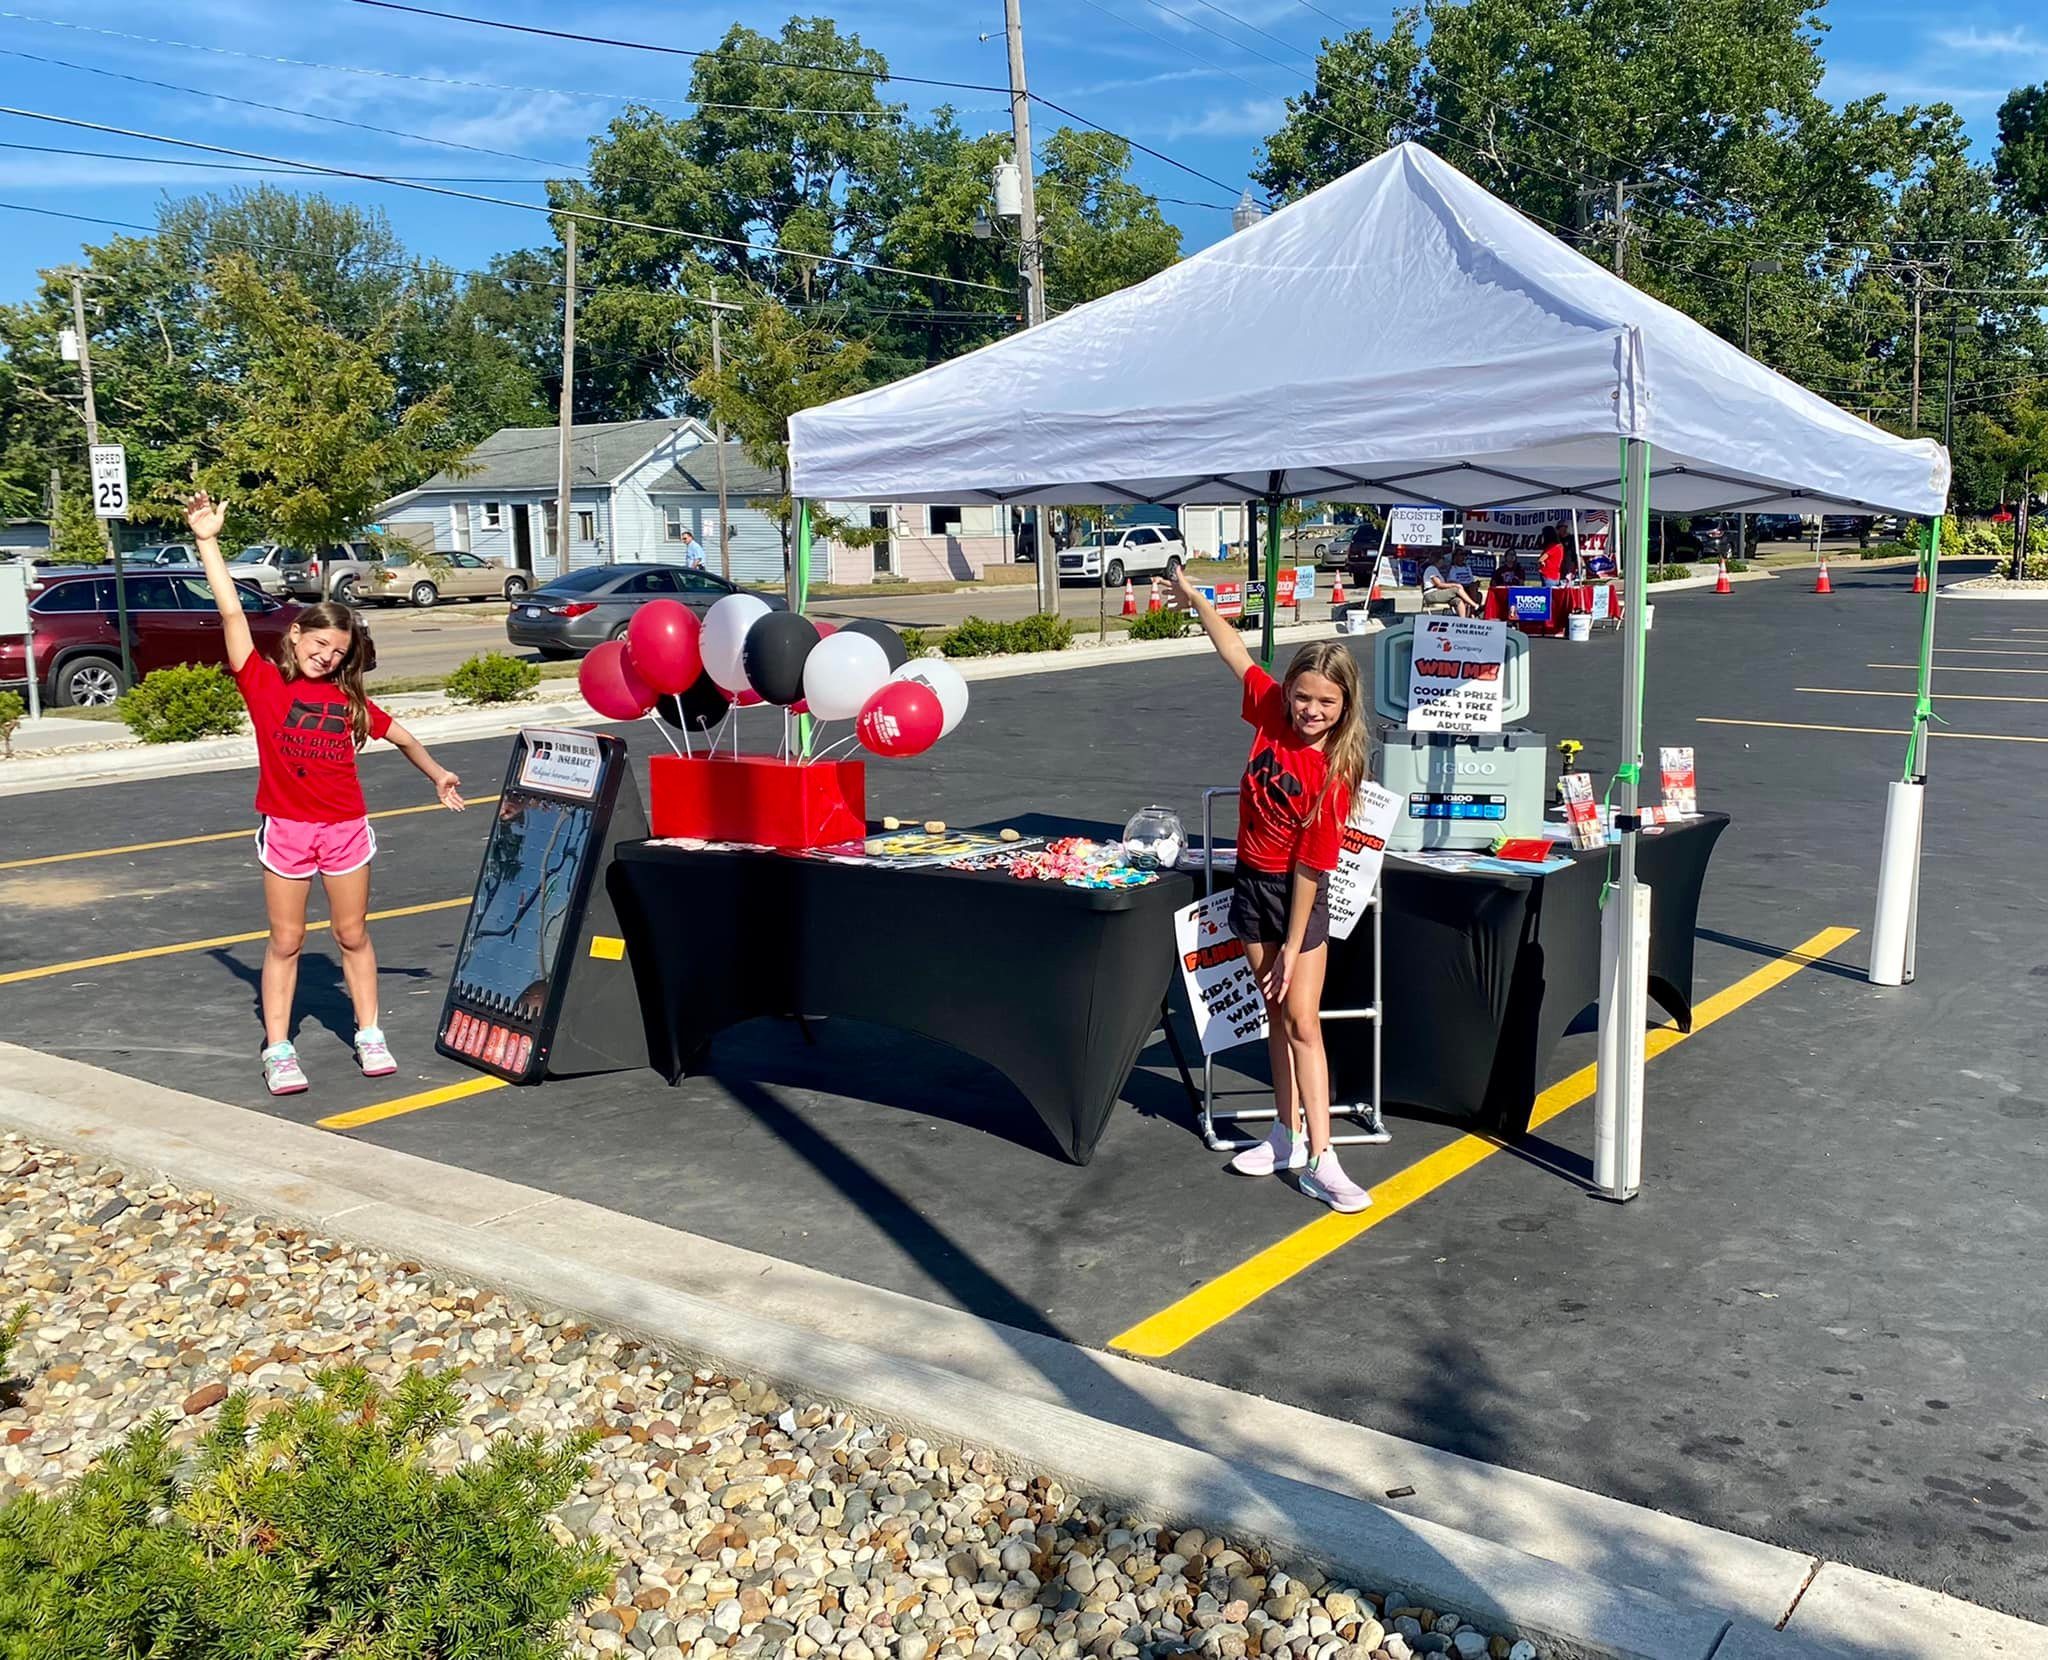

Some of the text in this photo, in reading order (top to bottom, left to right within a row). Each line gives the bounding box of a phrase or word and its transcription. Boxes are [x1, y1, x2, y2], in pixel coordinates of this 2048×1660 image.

[95, 453, 120, 465] SPEED
[98, 468, 119, 479] LIMIT
[98, 483, 123, 508] 25
[1392, 510, 1442, 521] REGISTER
[1514, 511, 1545, 526] Buren
[1410, 523, 1426, 533] TO
[1401, 533, 1433, 543] VOTE
[1464, 529, 1609, 551] REPUBLICA RTY
[1465, 556, 1494, 568] esbitt
[1515, 595, 1547, 603] TUDOR
[1453, 644, 1482, 653] Company
[1415, 658, 1461, 679] WIN
[1413, 686, 1498, 701] COOLER PRIZE
[1417, 698, 1494, 711] PACK. 1 FREE
[1422, 709, 1488, 722] ENTRY PER
[281, 746, 345, 761] INSURANC
[555, 742, 571, 753] FARM
[557, 755, 593, 768] INSURANCE
[1435, 762, 1496, 776] IGLOO
[1443, 794, 1473, 802] IGLOO
[1345, 860, 1360, 871] SEE
[1333, 875, 1356, 888] AUTO
[1335, 896, 1351, 906] GET
[1328, 903, 1356, 917] MAZON
[1328, 912, 1348, 924] DAY!
[1199, 977, 1233, 1003] KIDS
[1233, 966, 1253, 982] PL
[1207, 988, 1244, 1018] FREE
[1226, 997, 1259, 1024] WIN
[1233, 1013, 1269, 1039] PRIZ
